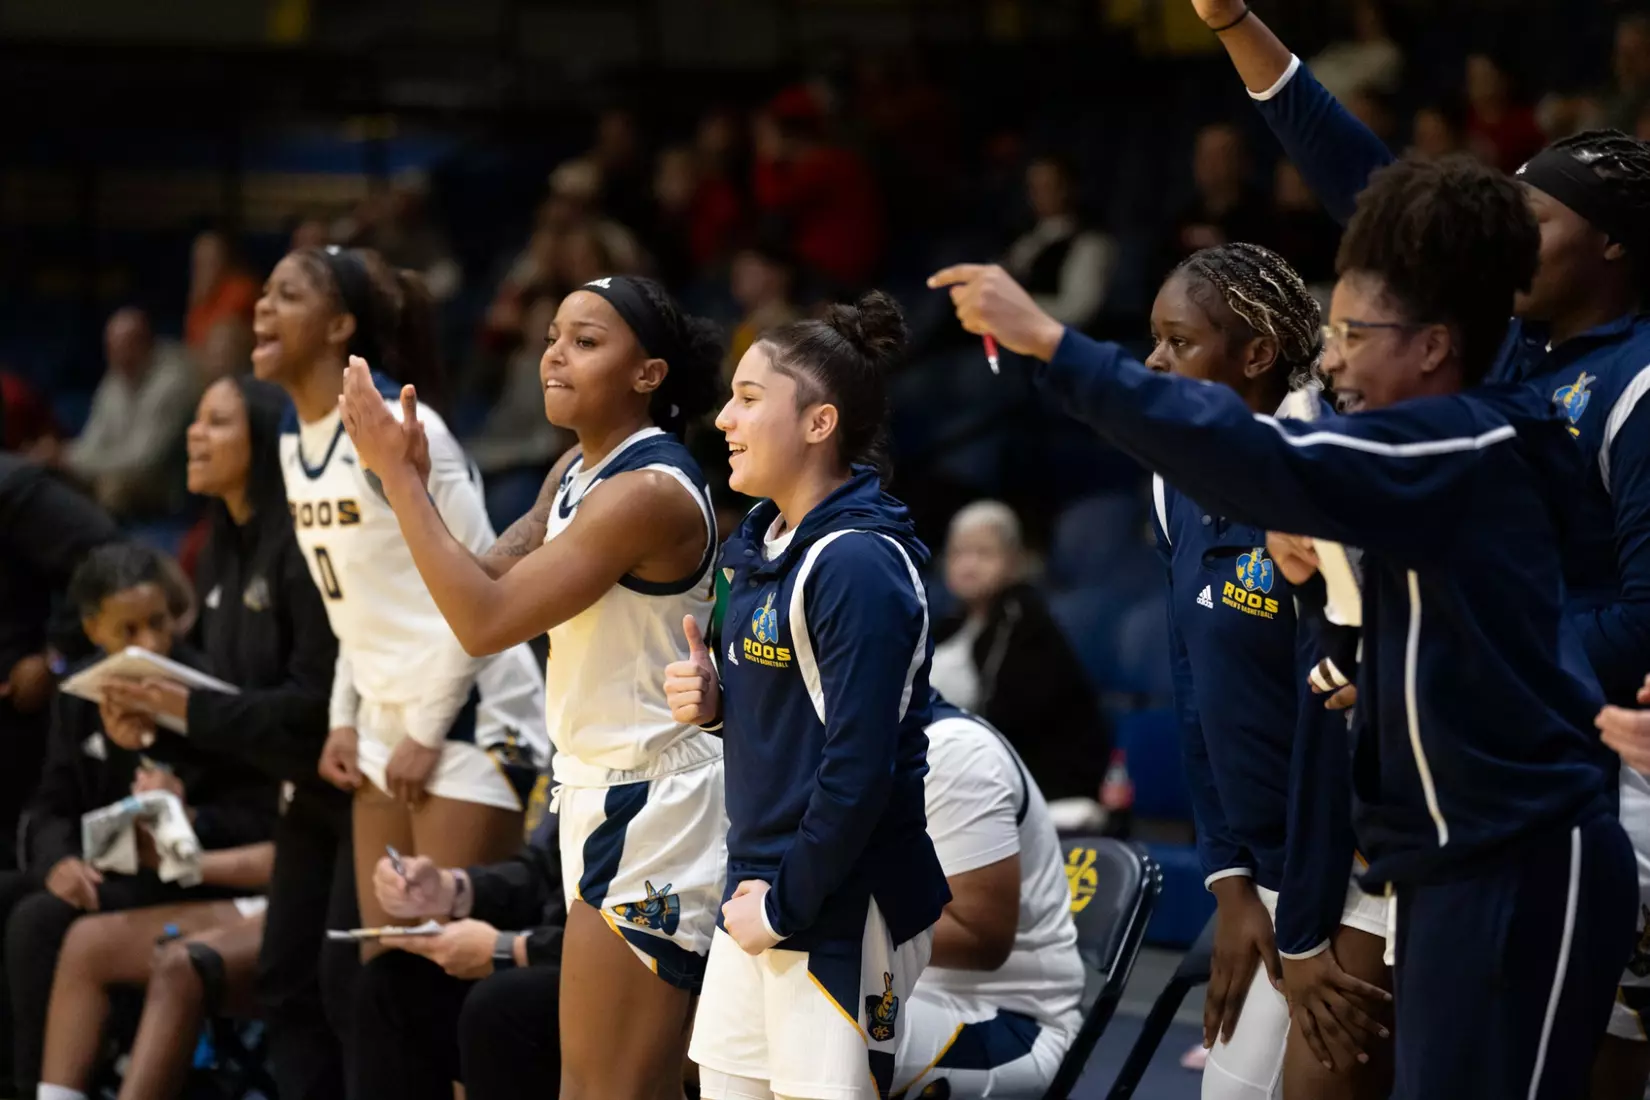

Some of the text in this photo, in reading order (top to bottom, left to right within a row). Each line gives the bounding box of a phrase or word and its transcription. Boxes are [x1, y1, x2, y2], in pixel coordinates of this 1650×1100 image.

[314, 546, 344, 600] 0
[1222, 580, 1279, 613] ROOS
[743, 637, 792, 661] ROOS
